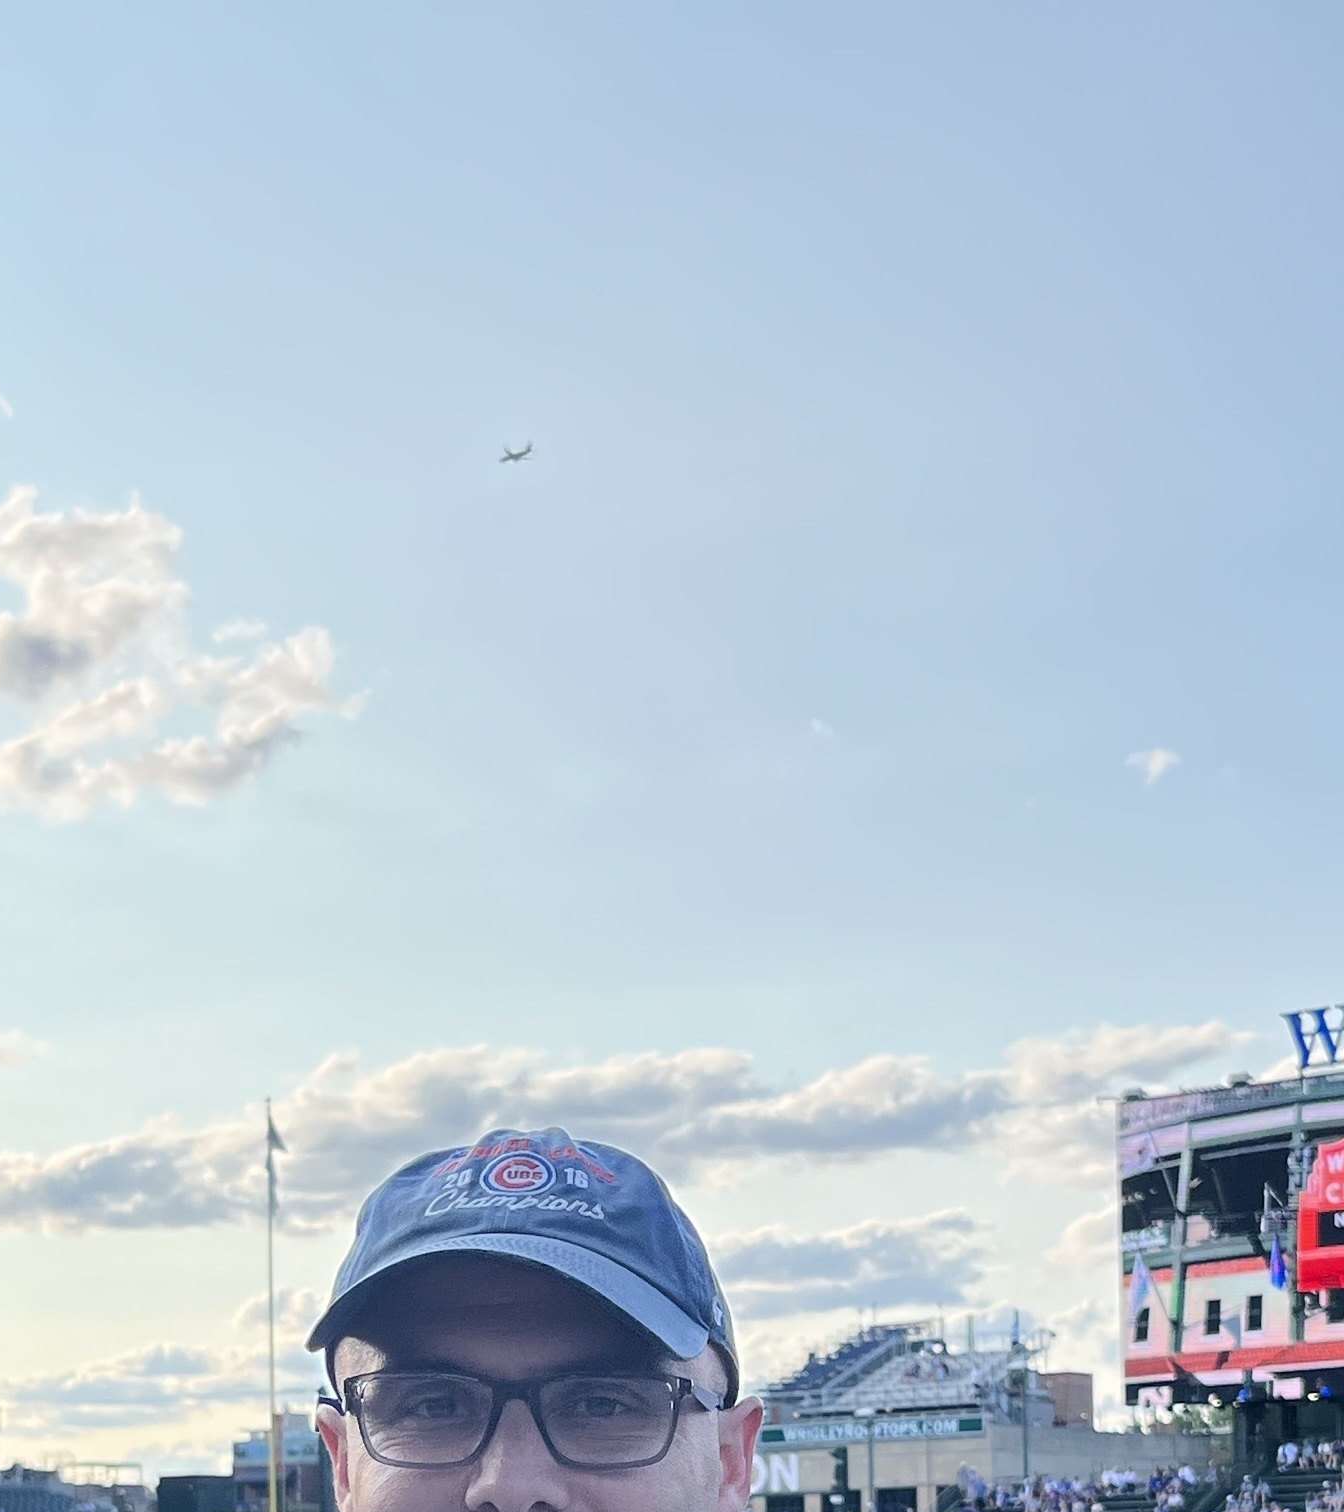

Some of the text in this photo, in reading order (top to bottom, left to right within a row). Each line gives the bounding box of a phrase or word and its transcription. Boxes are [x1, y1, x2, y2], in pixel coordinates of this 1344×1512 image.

[443, 1168, 472, 1190] 20
[564, 1167, 589, 1189] 16
[424, 1190, 605, 1220] Champions
